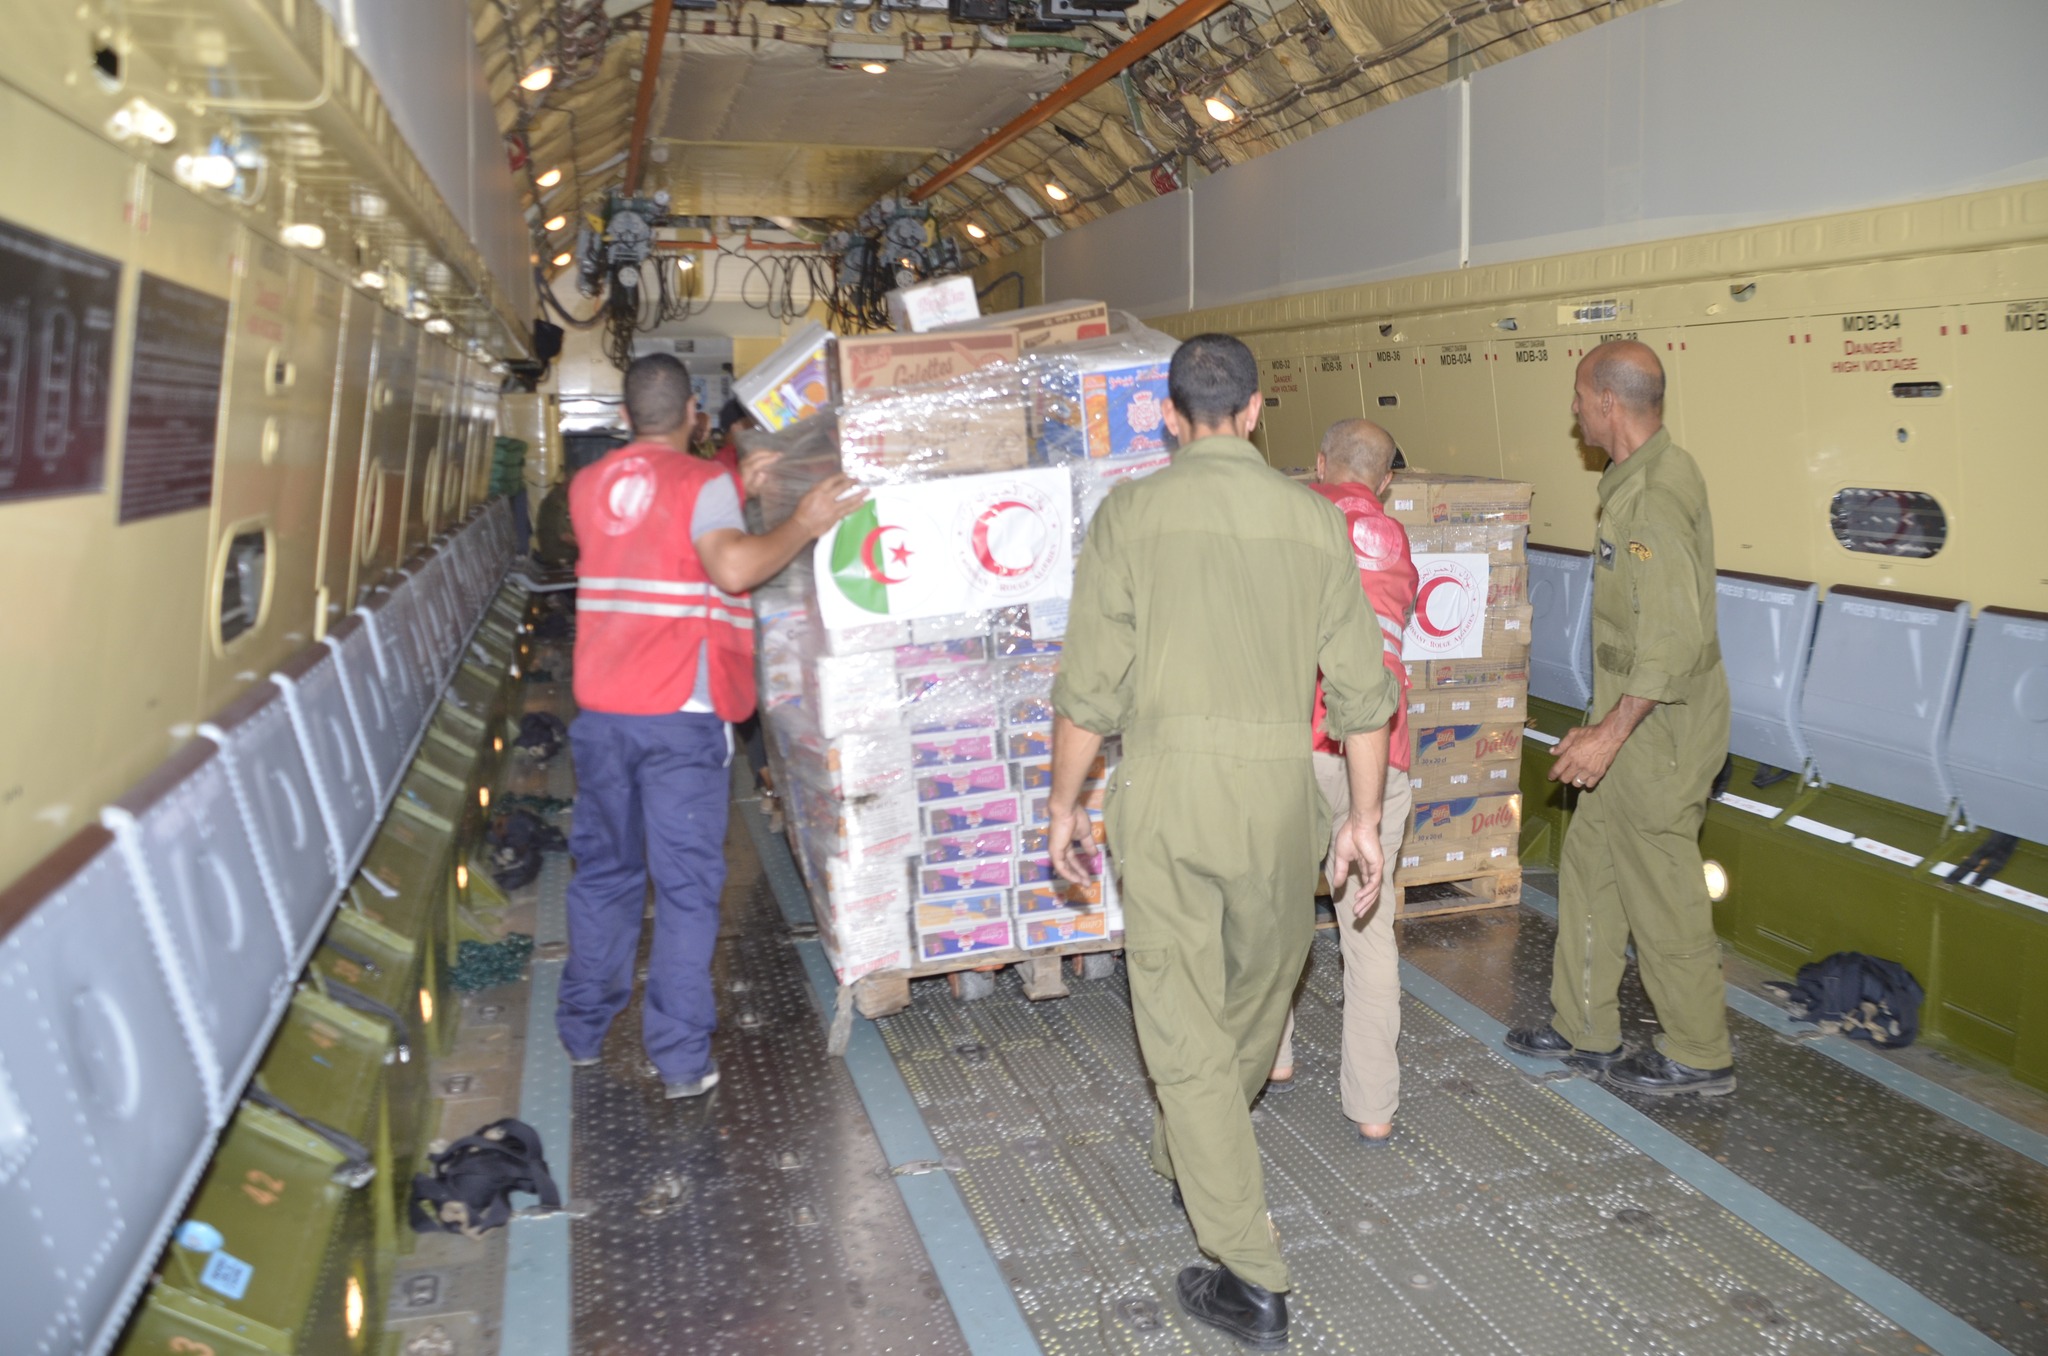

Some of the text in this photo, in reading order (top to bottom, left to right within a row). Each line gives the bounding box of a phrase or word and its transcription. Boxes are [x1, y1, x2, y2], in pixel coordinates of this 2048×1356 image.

[1842, 314, 1901, 332] MDB-34
[1376, 351, 1400, 362] MDB-36
[1440, 353, 1471, 365] MDB-034
[1516, 350, 1548, 362] MDB-38
[1832, 358, 1919, 373] HIGH VOLTAGE
[1476, 729, 1519, 758] Daily
[1472, 804, 1514, 834] Daily
